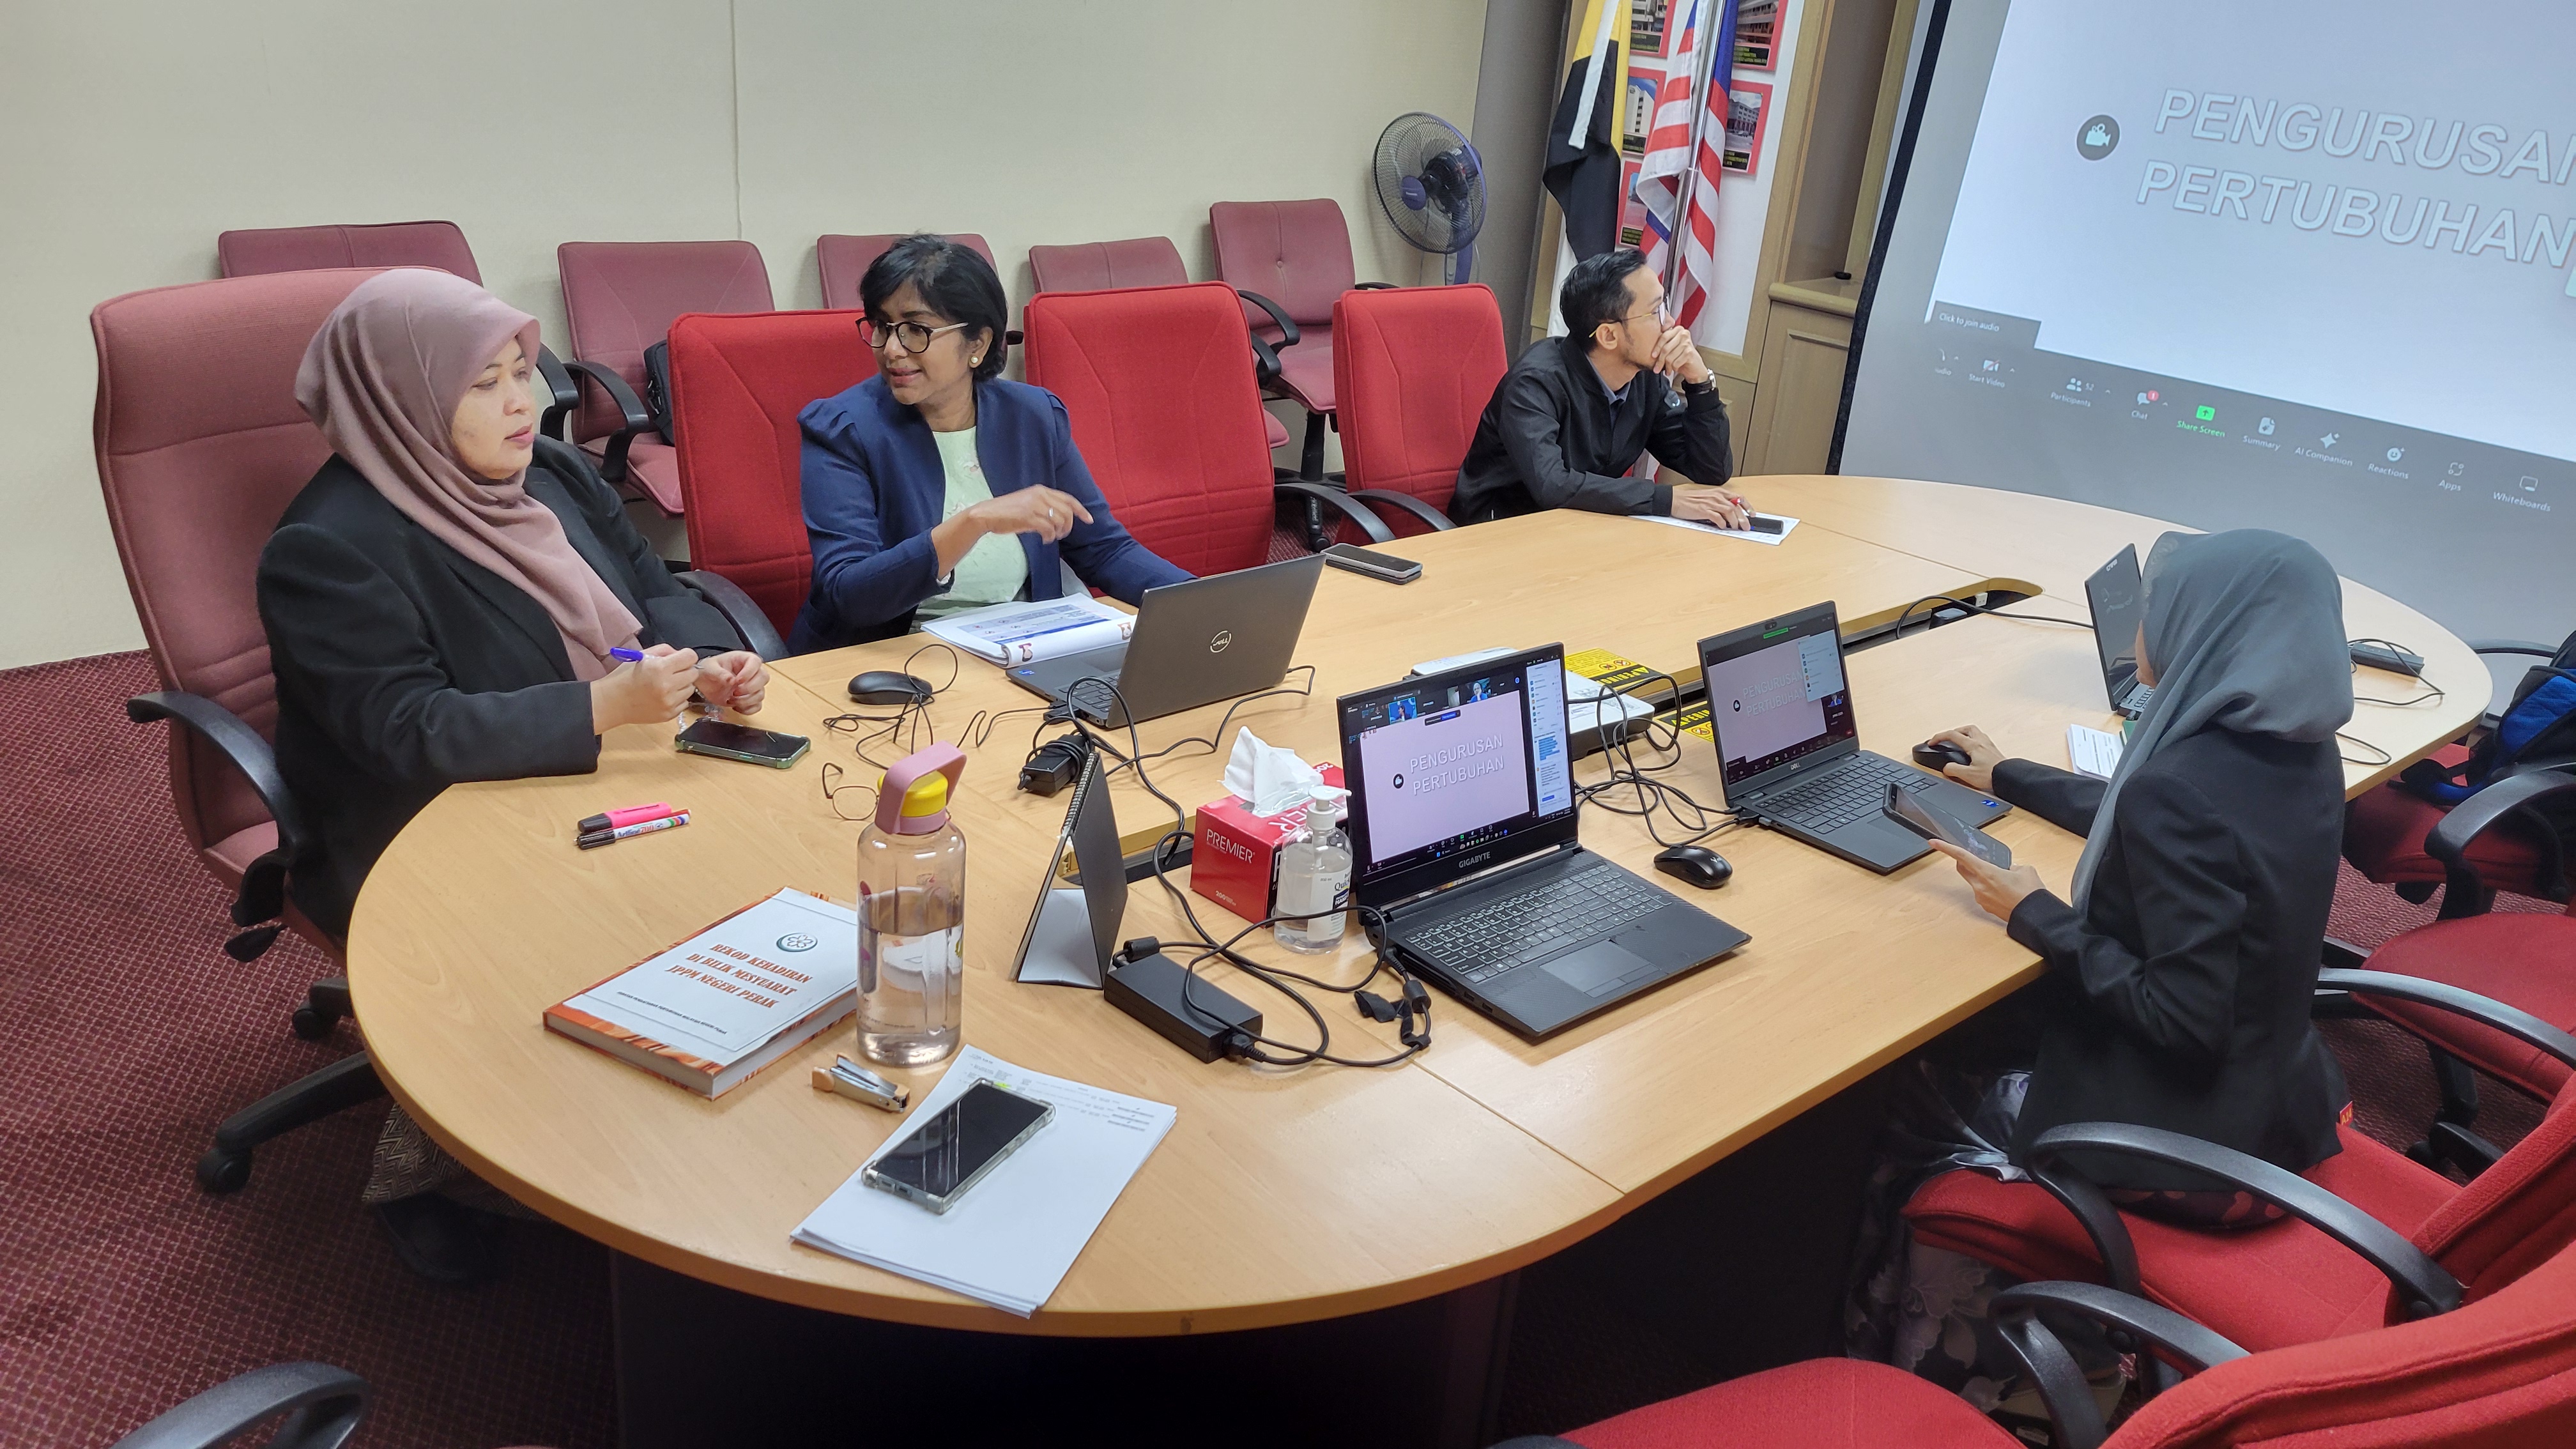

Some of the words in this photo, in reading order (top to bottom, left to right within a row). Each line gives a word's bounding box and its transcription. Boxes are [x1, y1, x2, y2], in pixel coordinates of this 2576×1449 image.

[2136, 159, 2576, 268] PERTUBUHAN
[1939, 312, 1955, 323] Click
[1956, 316, 1964, 325] to
[1963, 319, 1978, 328] join
[1980, 321, 2000, 332] audio
[1935, 367, 1952, 376] udio
[1968, 373, 1984, 383] Start
[1986, 378, 2005, 388] Video
[2051, 392, 2091, 408] Participants
[2131, 410, 2148, 420] Chat
[2176, 420, 2198, 431] Share
[2199, 425, 2225, 438] Screen
[2242, 435, 2281, 451] Summary
[2294, 447, 2304, 456] AI
[2306, 449, 2353, 467] Companion
[2368, 463, 2409, 479] Reactions
[2438, 480, 2462, 491] Apps
[2493, 492, 2551, 512] Whiteboards
[1743, 670, 1803, 700] PENGURUSAN
[1747, 688, 1805, 717] PERTUBUHAN
[1410, 734, 1503, 774] PENGURUSAN
[1413, 755, 1505, 795] PERTUBUHAN
[1206, 829, 1252, 864] PREMIER
[1459, 851, 1491, 868] GIGABYTE
[710, 944, 750, 960] REKOD
[747, 957, 813, 983] KEHADIRAN
[686, 953, 704, 962] DI
[702, 957, 735, 973] BILIK
[732, 969, 798, 995] MESYUARAT
[664, 965, 702, 978] JPPM
[696, 974, 742, 993] NEGERI
[736, 990, 780, 1008] PERAK
